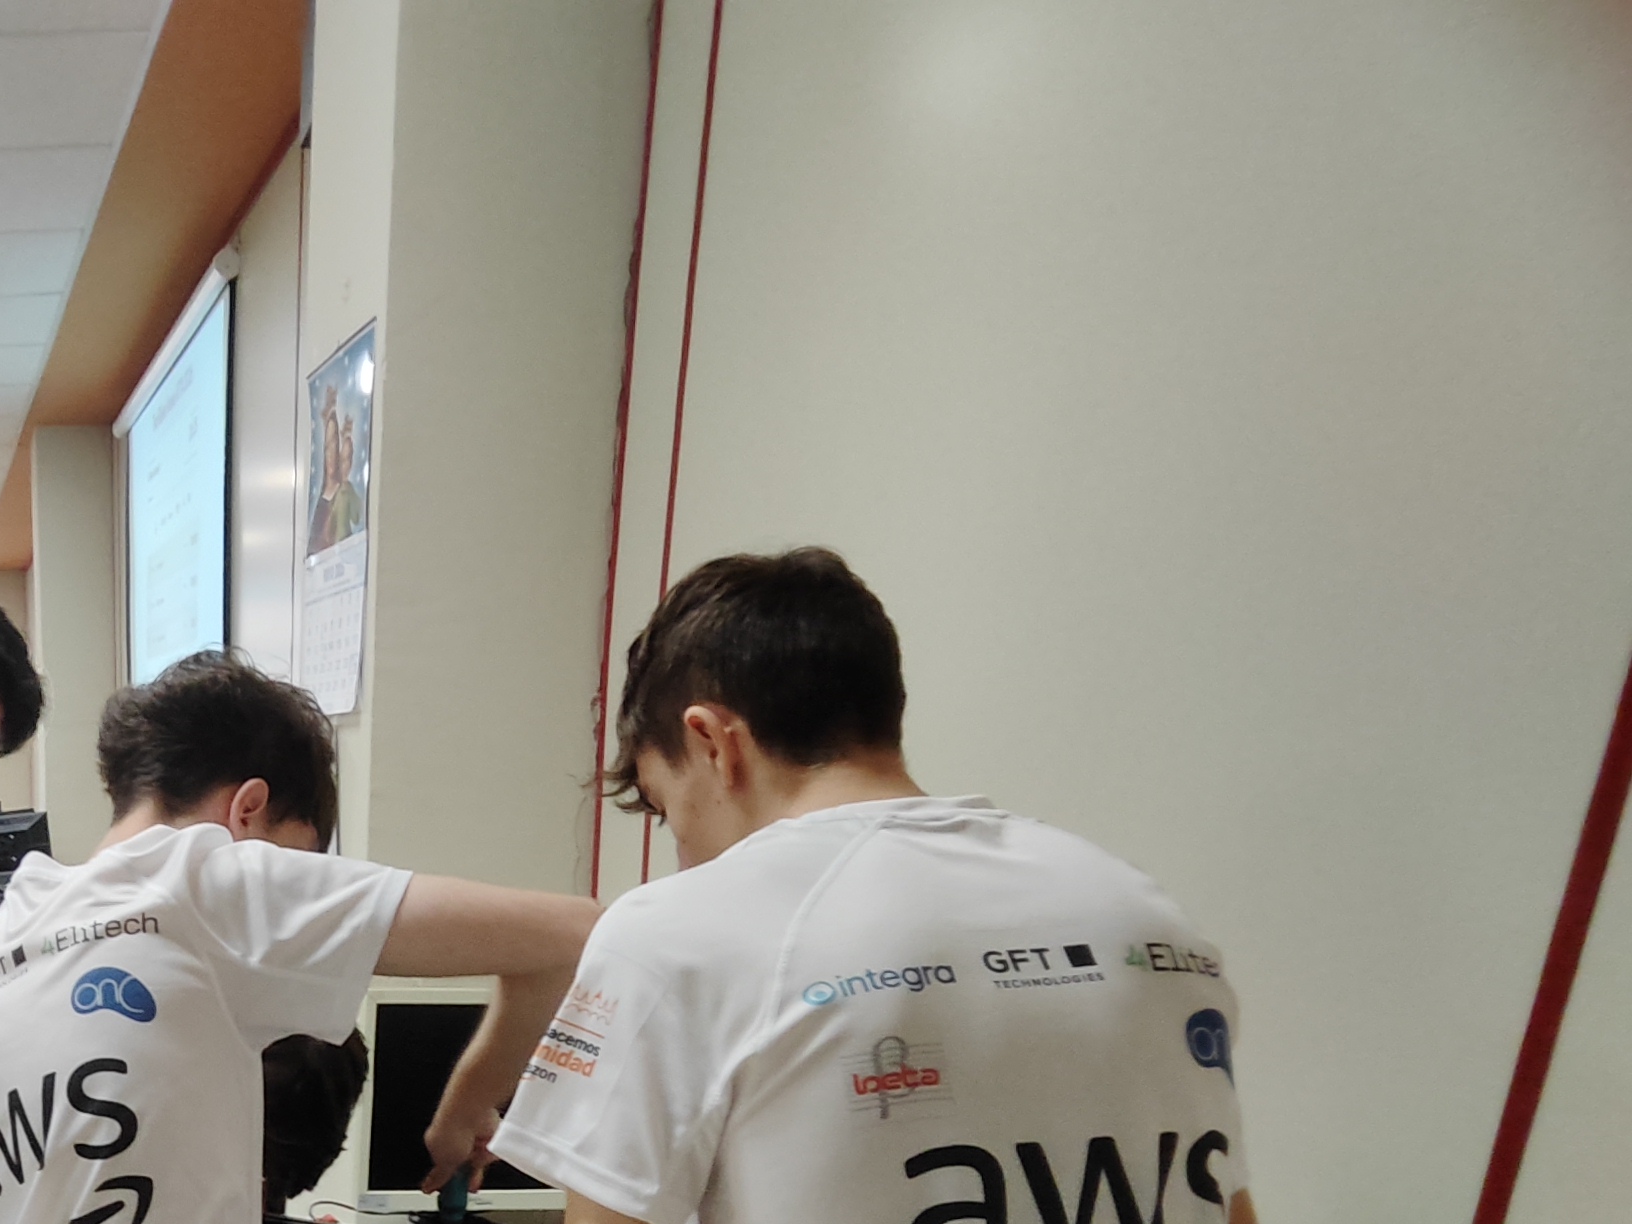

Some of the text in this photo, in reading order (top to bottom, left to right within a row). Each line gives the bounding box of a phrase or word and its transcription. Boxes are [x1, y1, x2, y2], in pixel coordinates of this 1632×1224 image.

[40, 912, 159, 956] 4Elitech
[982, 946, 1051, 977] GFT
[993, 971, 1106, 990] TECHNOLOGIES
[545, 1028, 601, 1057] acemos
[534, 1043, 597, 1078] nidad
